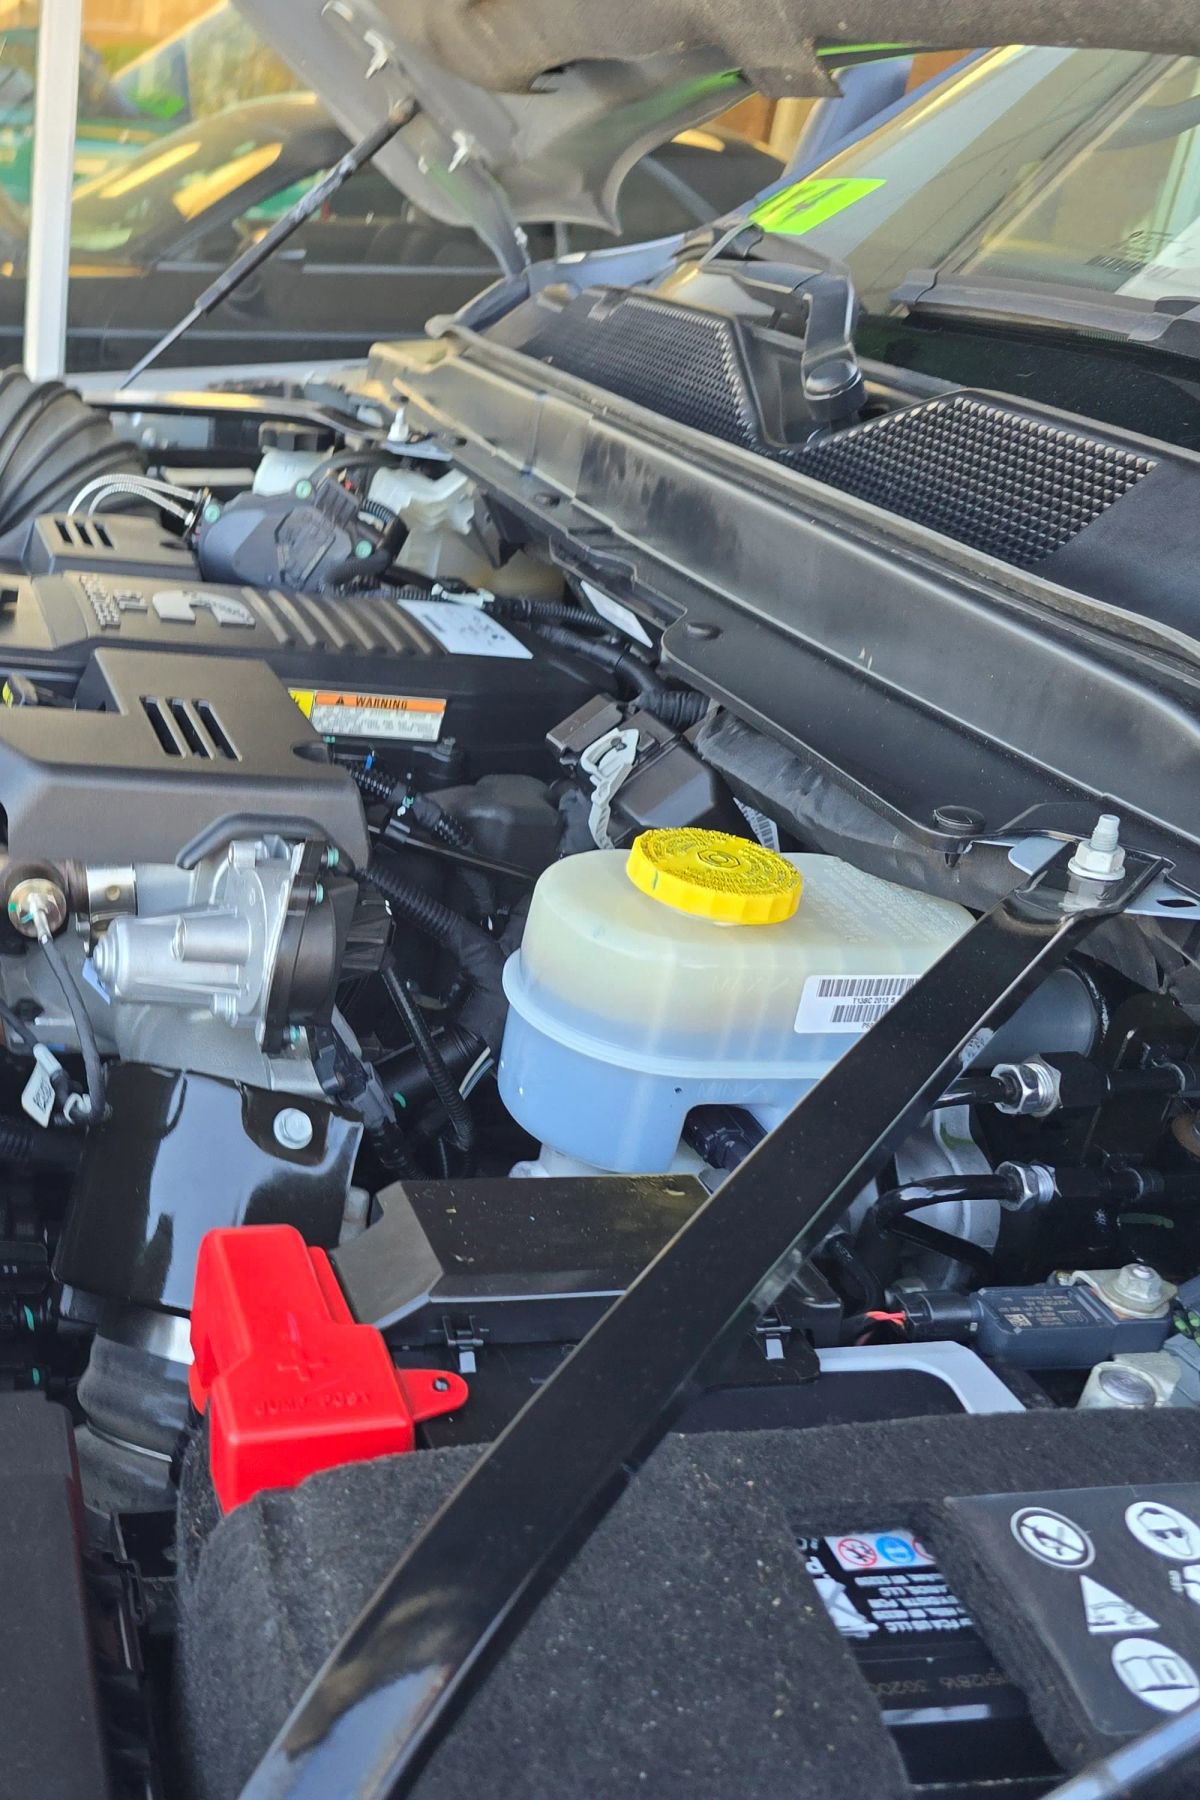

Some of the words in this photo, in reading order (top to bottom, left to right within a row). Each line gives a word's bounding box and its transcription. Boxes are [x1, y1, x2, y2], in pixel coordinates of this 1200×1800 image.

[355, 695, 408, 711] WARNING
[878, 1586, 907, 1597] LLC
[884, 1621, 912, 1633] LLC
[931, 1618, 960, 1631] FCA
